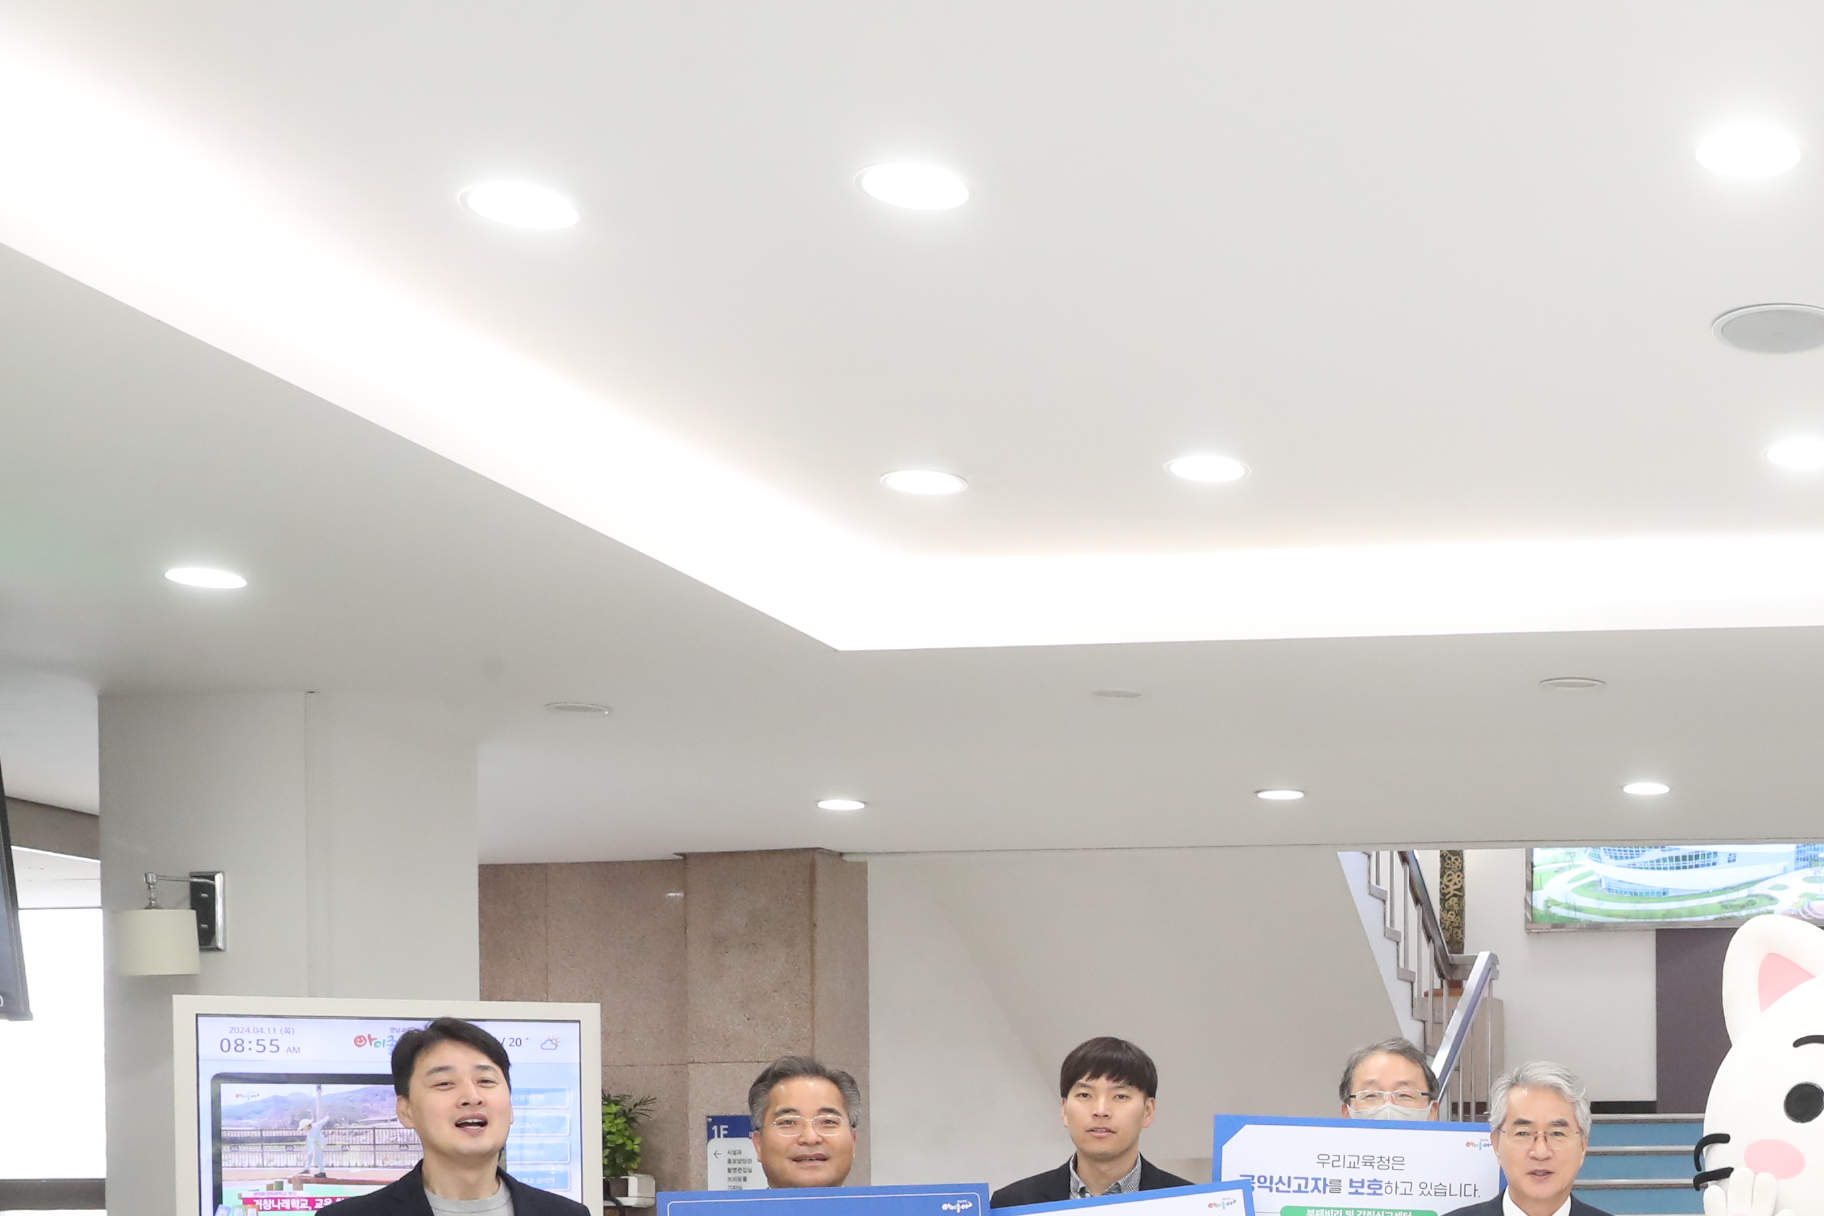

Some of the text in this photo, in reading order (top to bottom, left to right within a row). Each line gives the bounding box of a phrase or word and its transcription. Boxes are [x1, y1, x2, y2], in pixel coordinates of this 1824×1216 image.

[280, 1027, 295, 1035] (목)
[220, 1038, 301, 1054] 08:55 AM
[712, 1125, 729, 1138] 1F
[1316, 1154, 1406, 1170] 우리교육청은
[1348, 1178, 1480, 1198] 보호하고 있습니다.
[253, 1199, 312, 1210] 거창나래학교,
